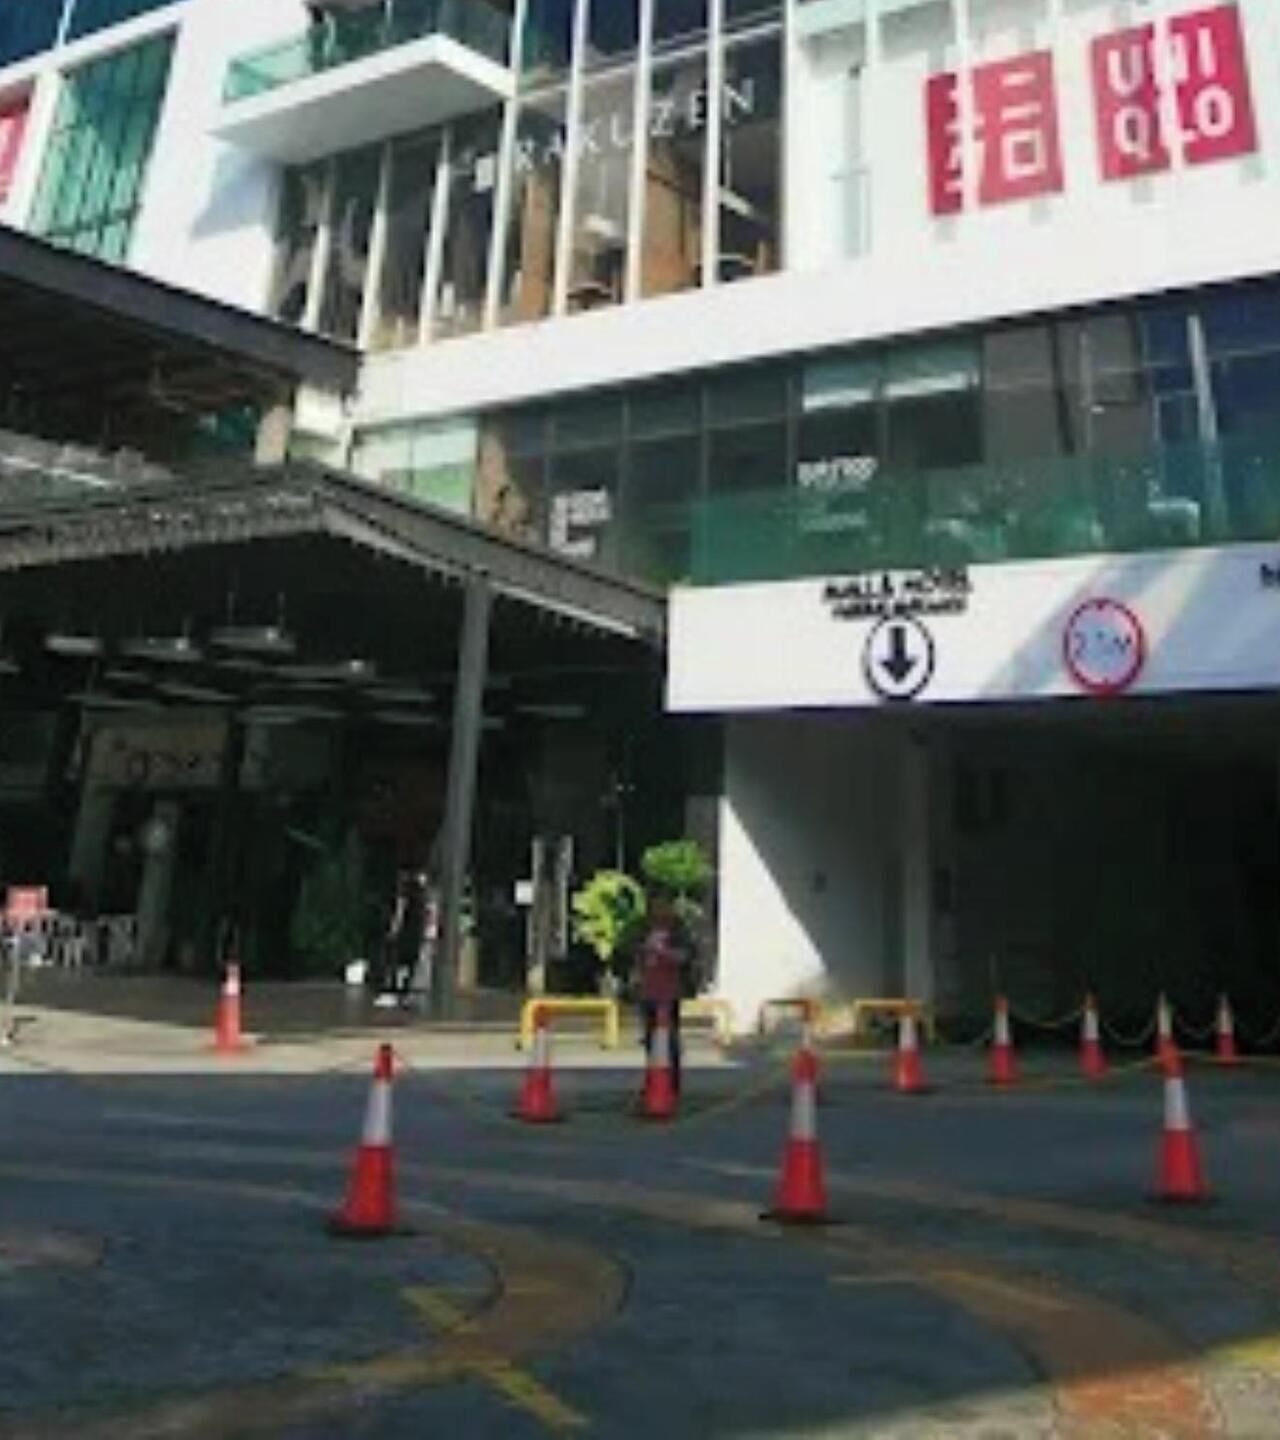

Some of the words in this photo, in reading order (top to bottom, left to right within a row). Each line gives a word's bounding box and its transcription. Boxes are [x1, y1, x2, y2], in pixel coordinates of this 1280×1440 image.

[1106, 26, 1217, 97] UNI
[515, 77, 755, 172] RAKUZEN
[1111, 84, 1236, 162] QLO
